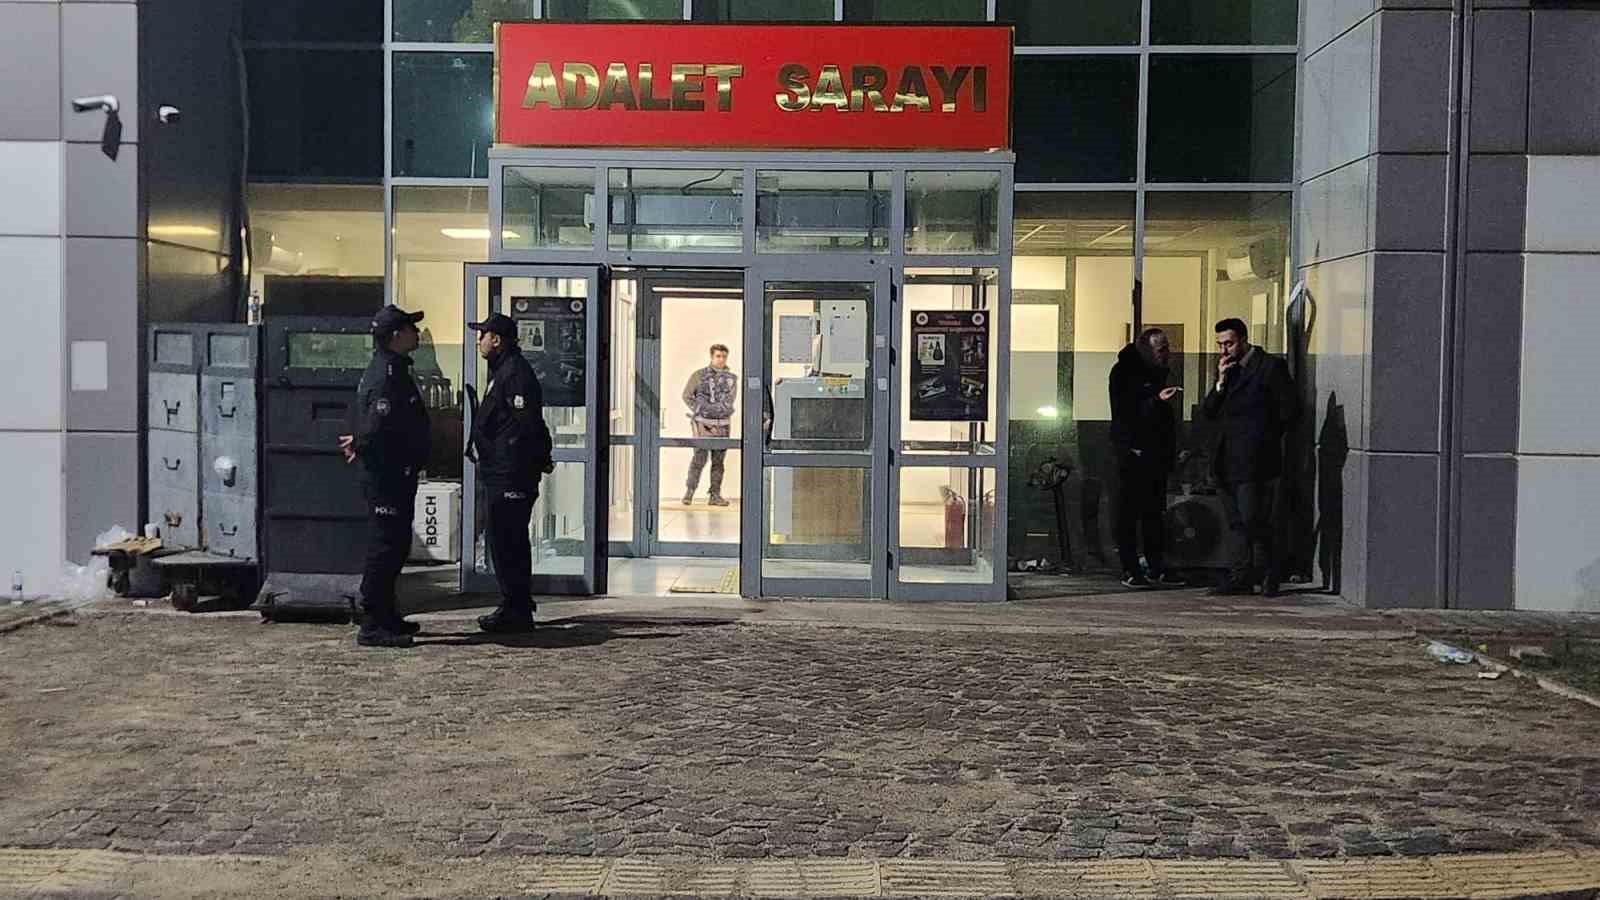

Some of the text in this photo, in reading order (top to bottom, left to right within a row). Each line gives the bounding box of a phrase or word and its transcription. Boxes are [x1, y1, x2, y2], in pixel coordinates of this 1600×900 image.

[521, 62, 988, 113] ADALET SARAYI
[425, 495, 437, 545] BOSCH
